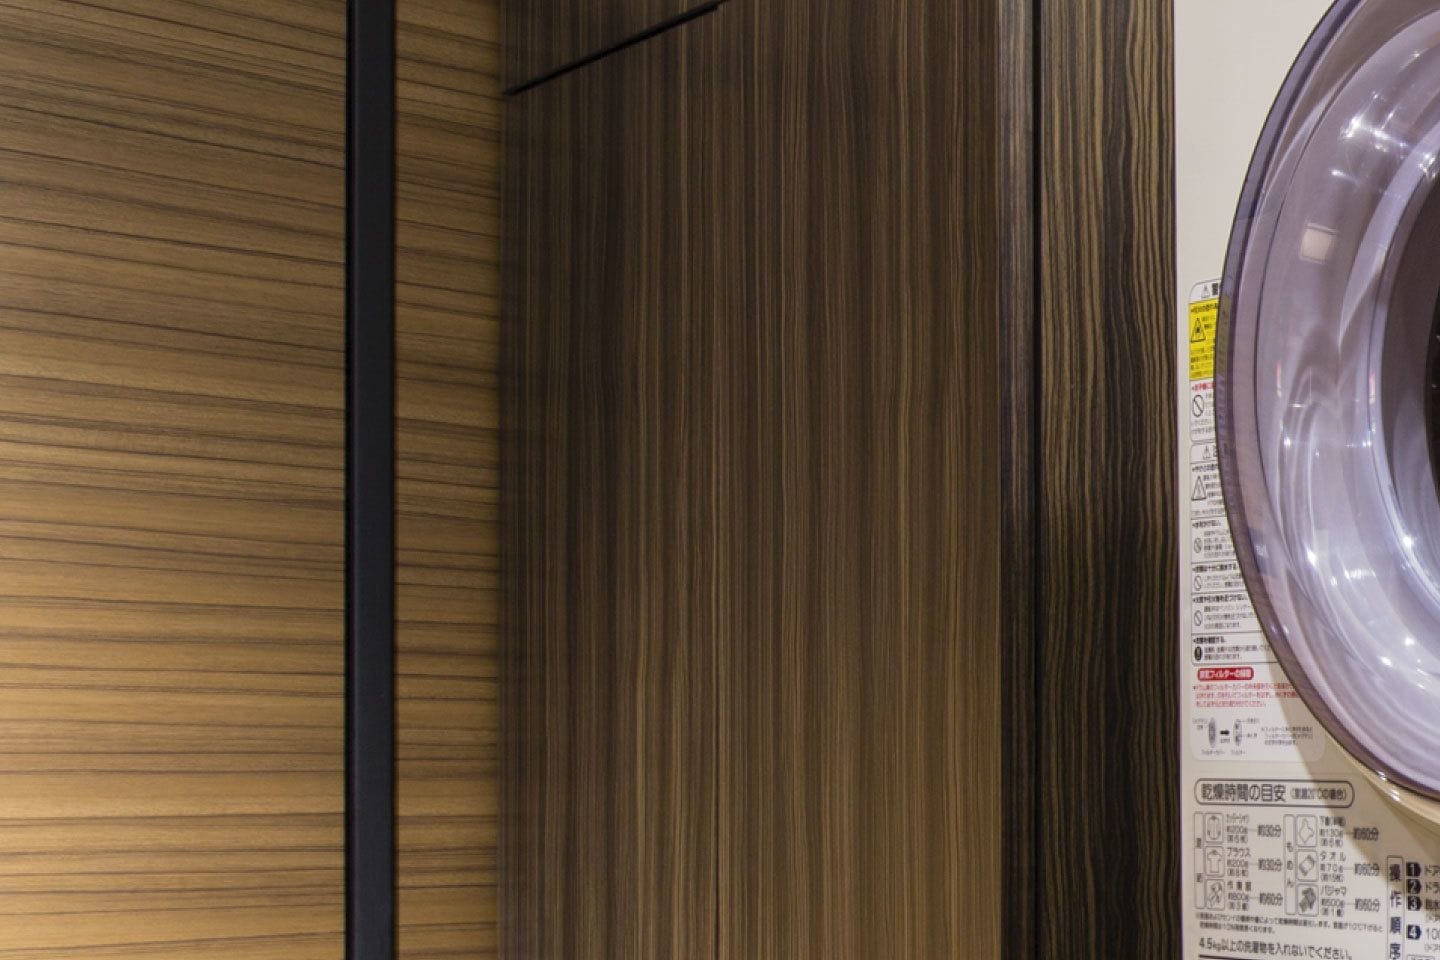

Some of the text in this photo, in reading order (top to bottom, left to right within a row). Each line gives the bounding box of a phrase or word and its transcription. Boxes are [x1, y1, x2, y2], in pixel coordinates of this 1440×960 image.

[1201, 783, 1287, 802] 乾燥時間の目安
